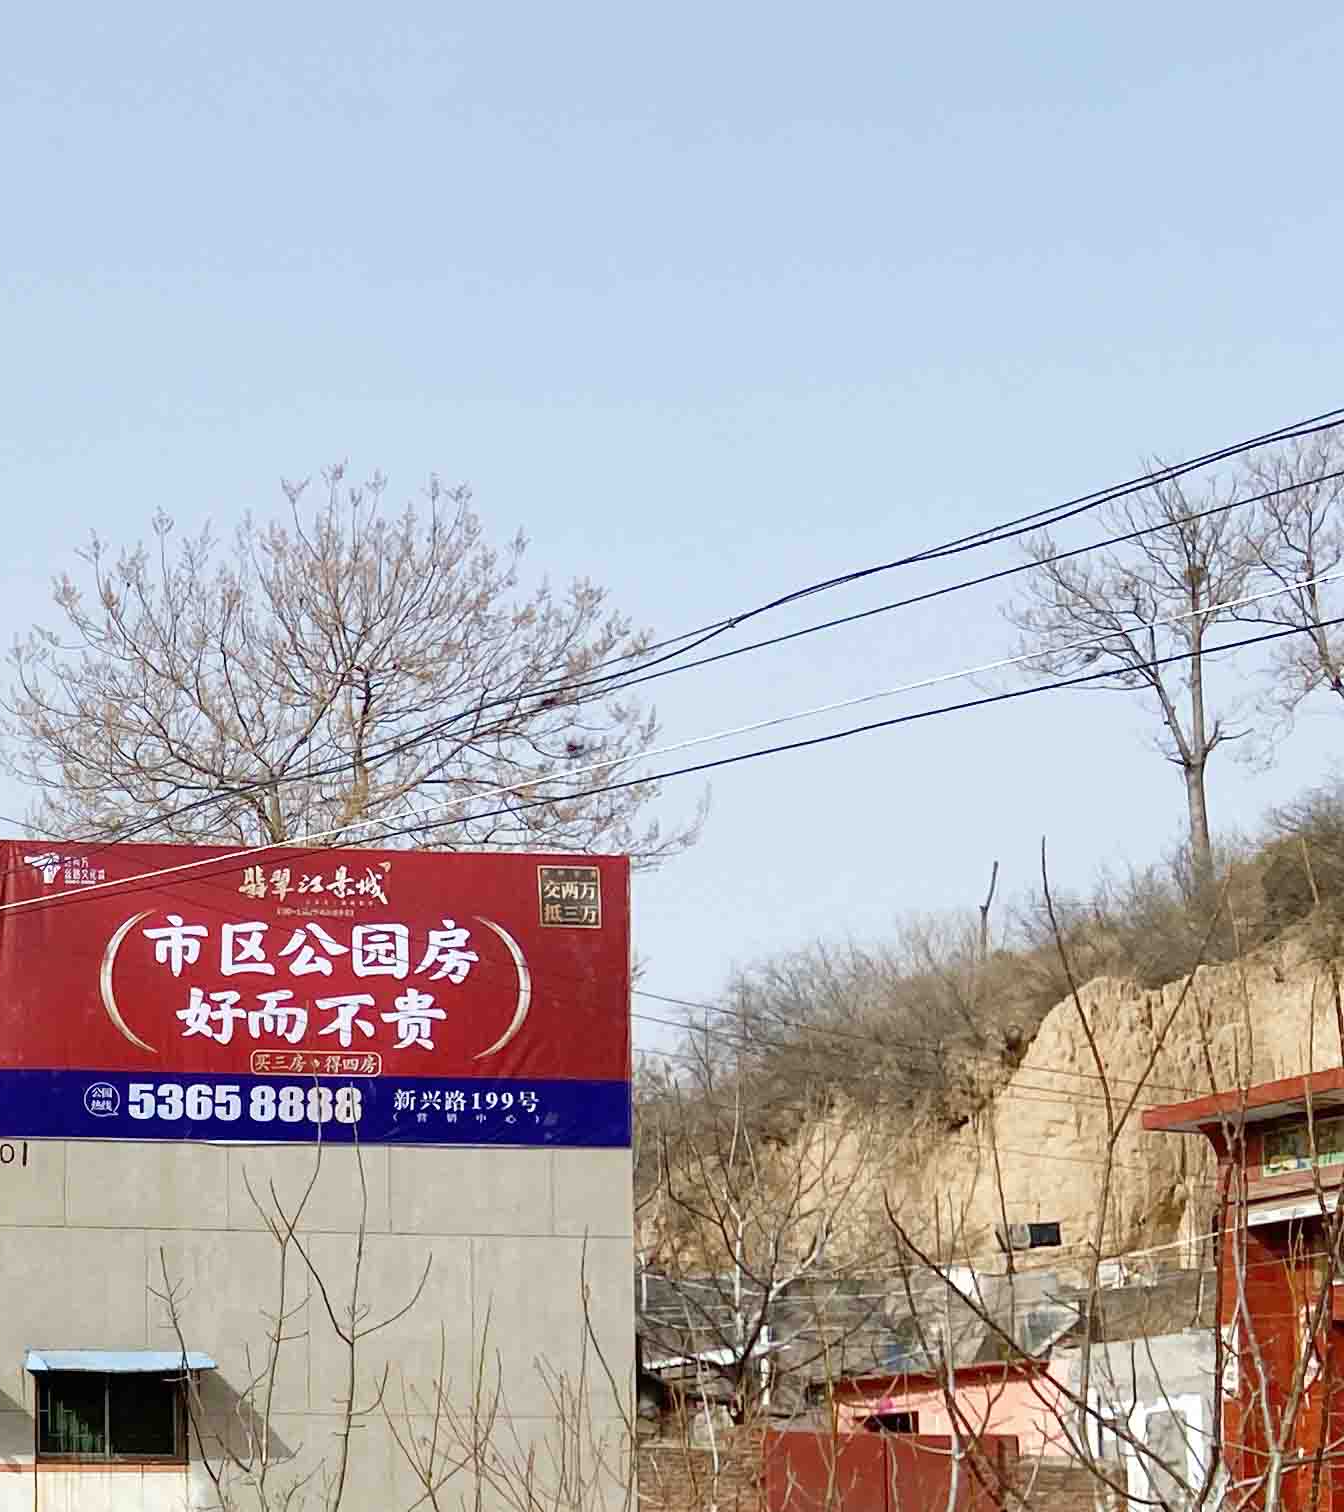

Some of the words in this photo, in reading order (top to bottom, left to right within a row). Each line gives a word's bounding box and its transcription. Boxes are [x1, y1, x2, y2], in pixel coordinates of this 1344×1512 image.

[543, 880, 597, 900] 交两万
[543, 903, 598, 923] 抵三万
[142, 914, 480, 985] 市区公园房
[175, 986, 448, 1051] 好而不贵
[128, 1083, 242, 1121] 5365
[249, 1085, 363, 1124] 8888
[393, 1089, 540, 1113] 新兴路199号
